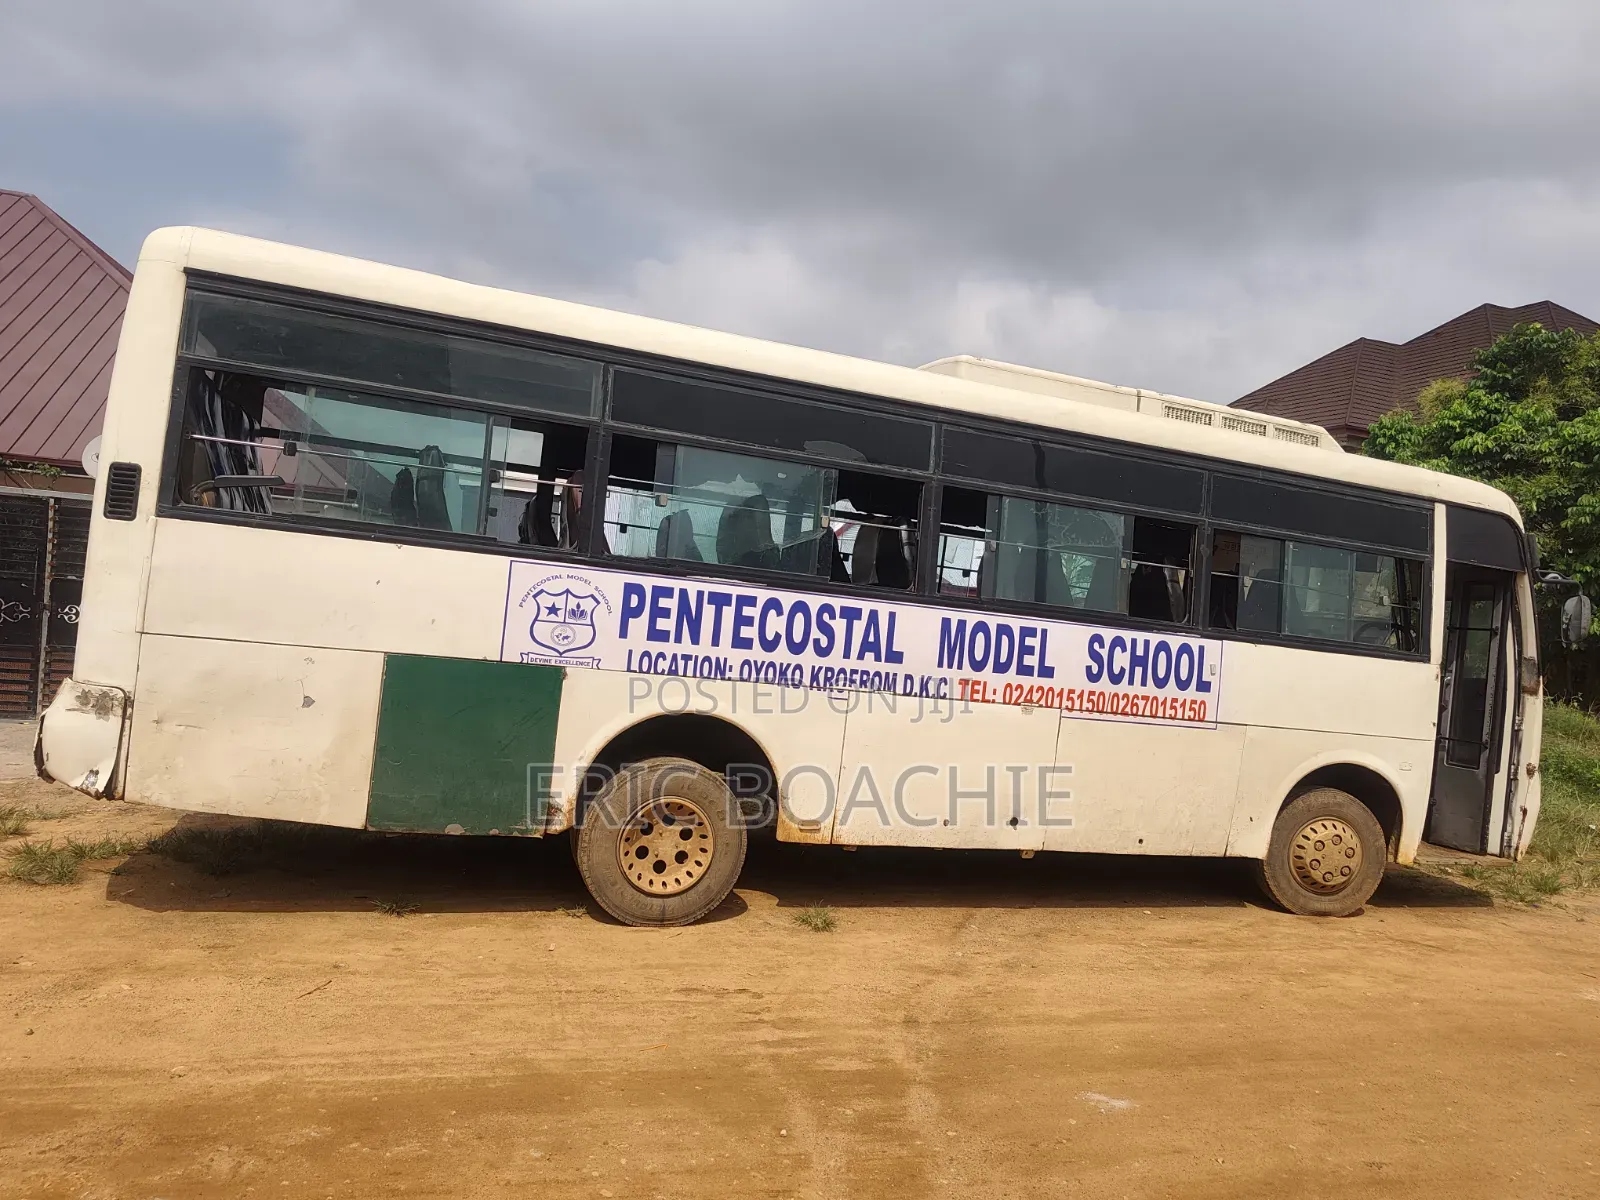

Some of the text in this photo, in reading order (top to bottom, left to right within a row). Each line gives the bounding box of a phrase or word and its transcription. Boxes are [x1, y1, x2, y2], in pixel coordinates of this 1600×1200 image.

[518, 574, 613, 616] PENTECOSTAL MODEL SCHOOL
[554, 658, 591, 667] EXCELLENCE
[618, 581, 1212, 693] PENTECOSTAL MODEL SCHOOL
[626, 649, 733, 681] LOCATION:
[739, 658, 803, 690] OYOKO
[958, 678, 997, 704] TEL:
[1002, 682, 1207, 722] 0242015150/0267015150
